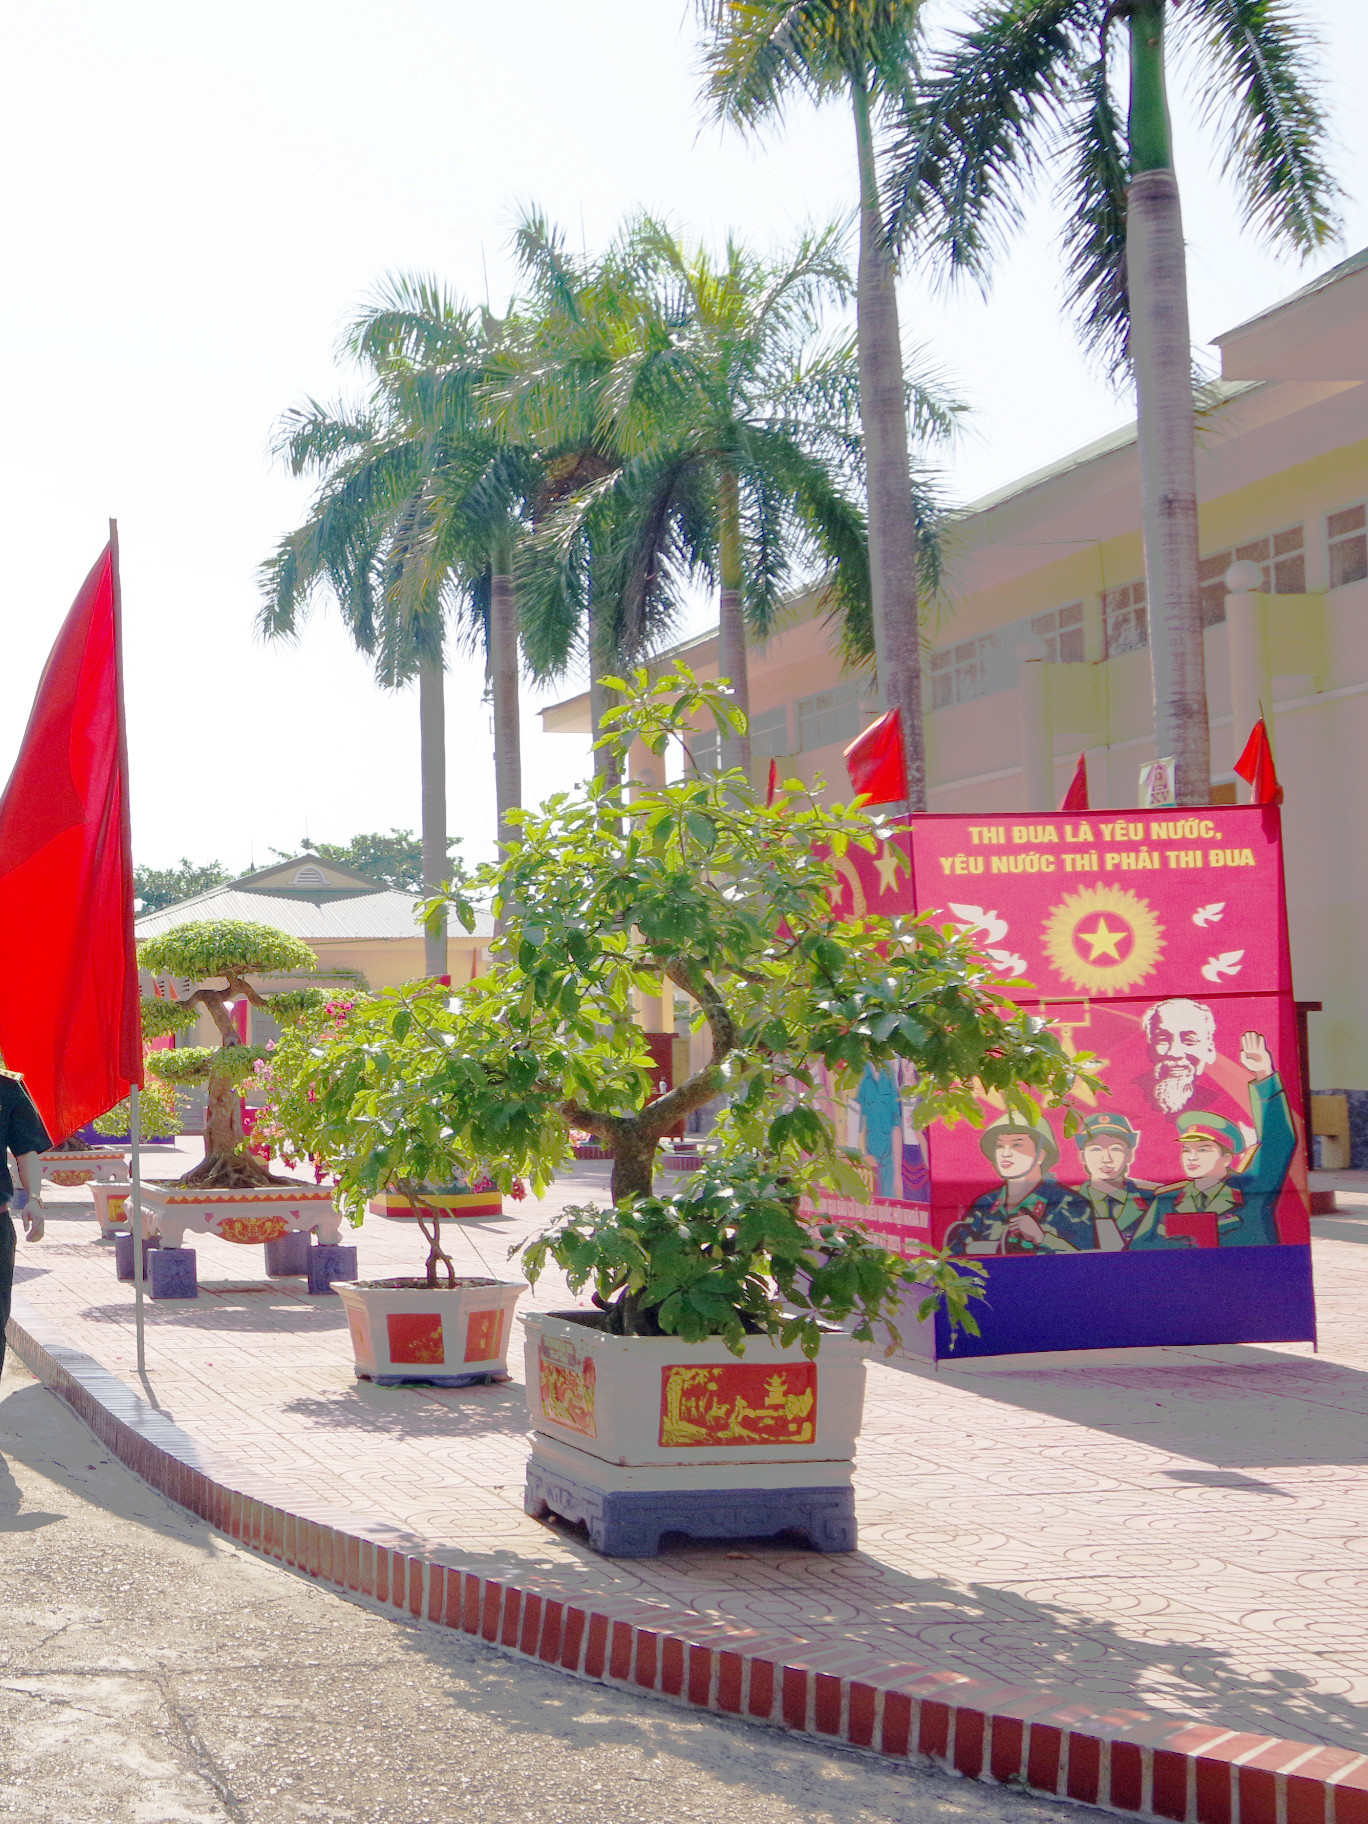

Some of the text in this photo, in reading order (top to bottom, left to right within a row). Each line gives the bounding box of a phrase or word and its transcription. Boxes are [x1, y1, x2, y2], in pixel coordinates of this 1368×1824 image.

[968, 817, 1223, 844] THI ĐUA LÀ YÊU NƯỚC,
[939, 846, 1256, 875] YÊU NƯỚC THÌ PHẢI THI ĐUA
